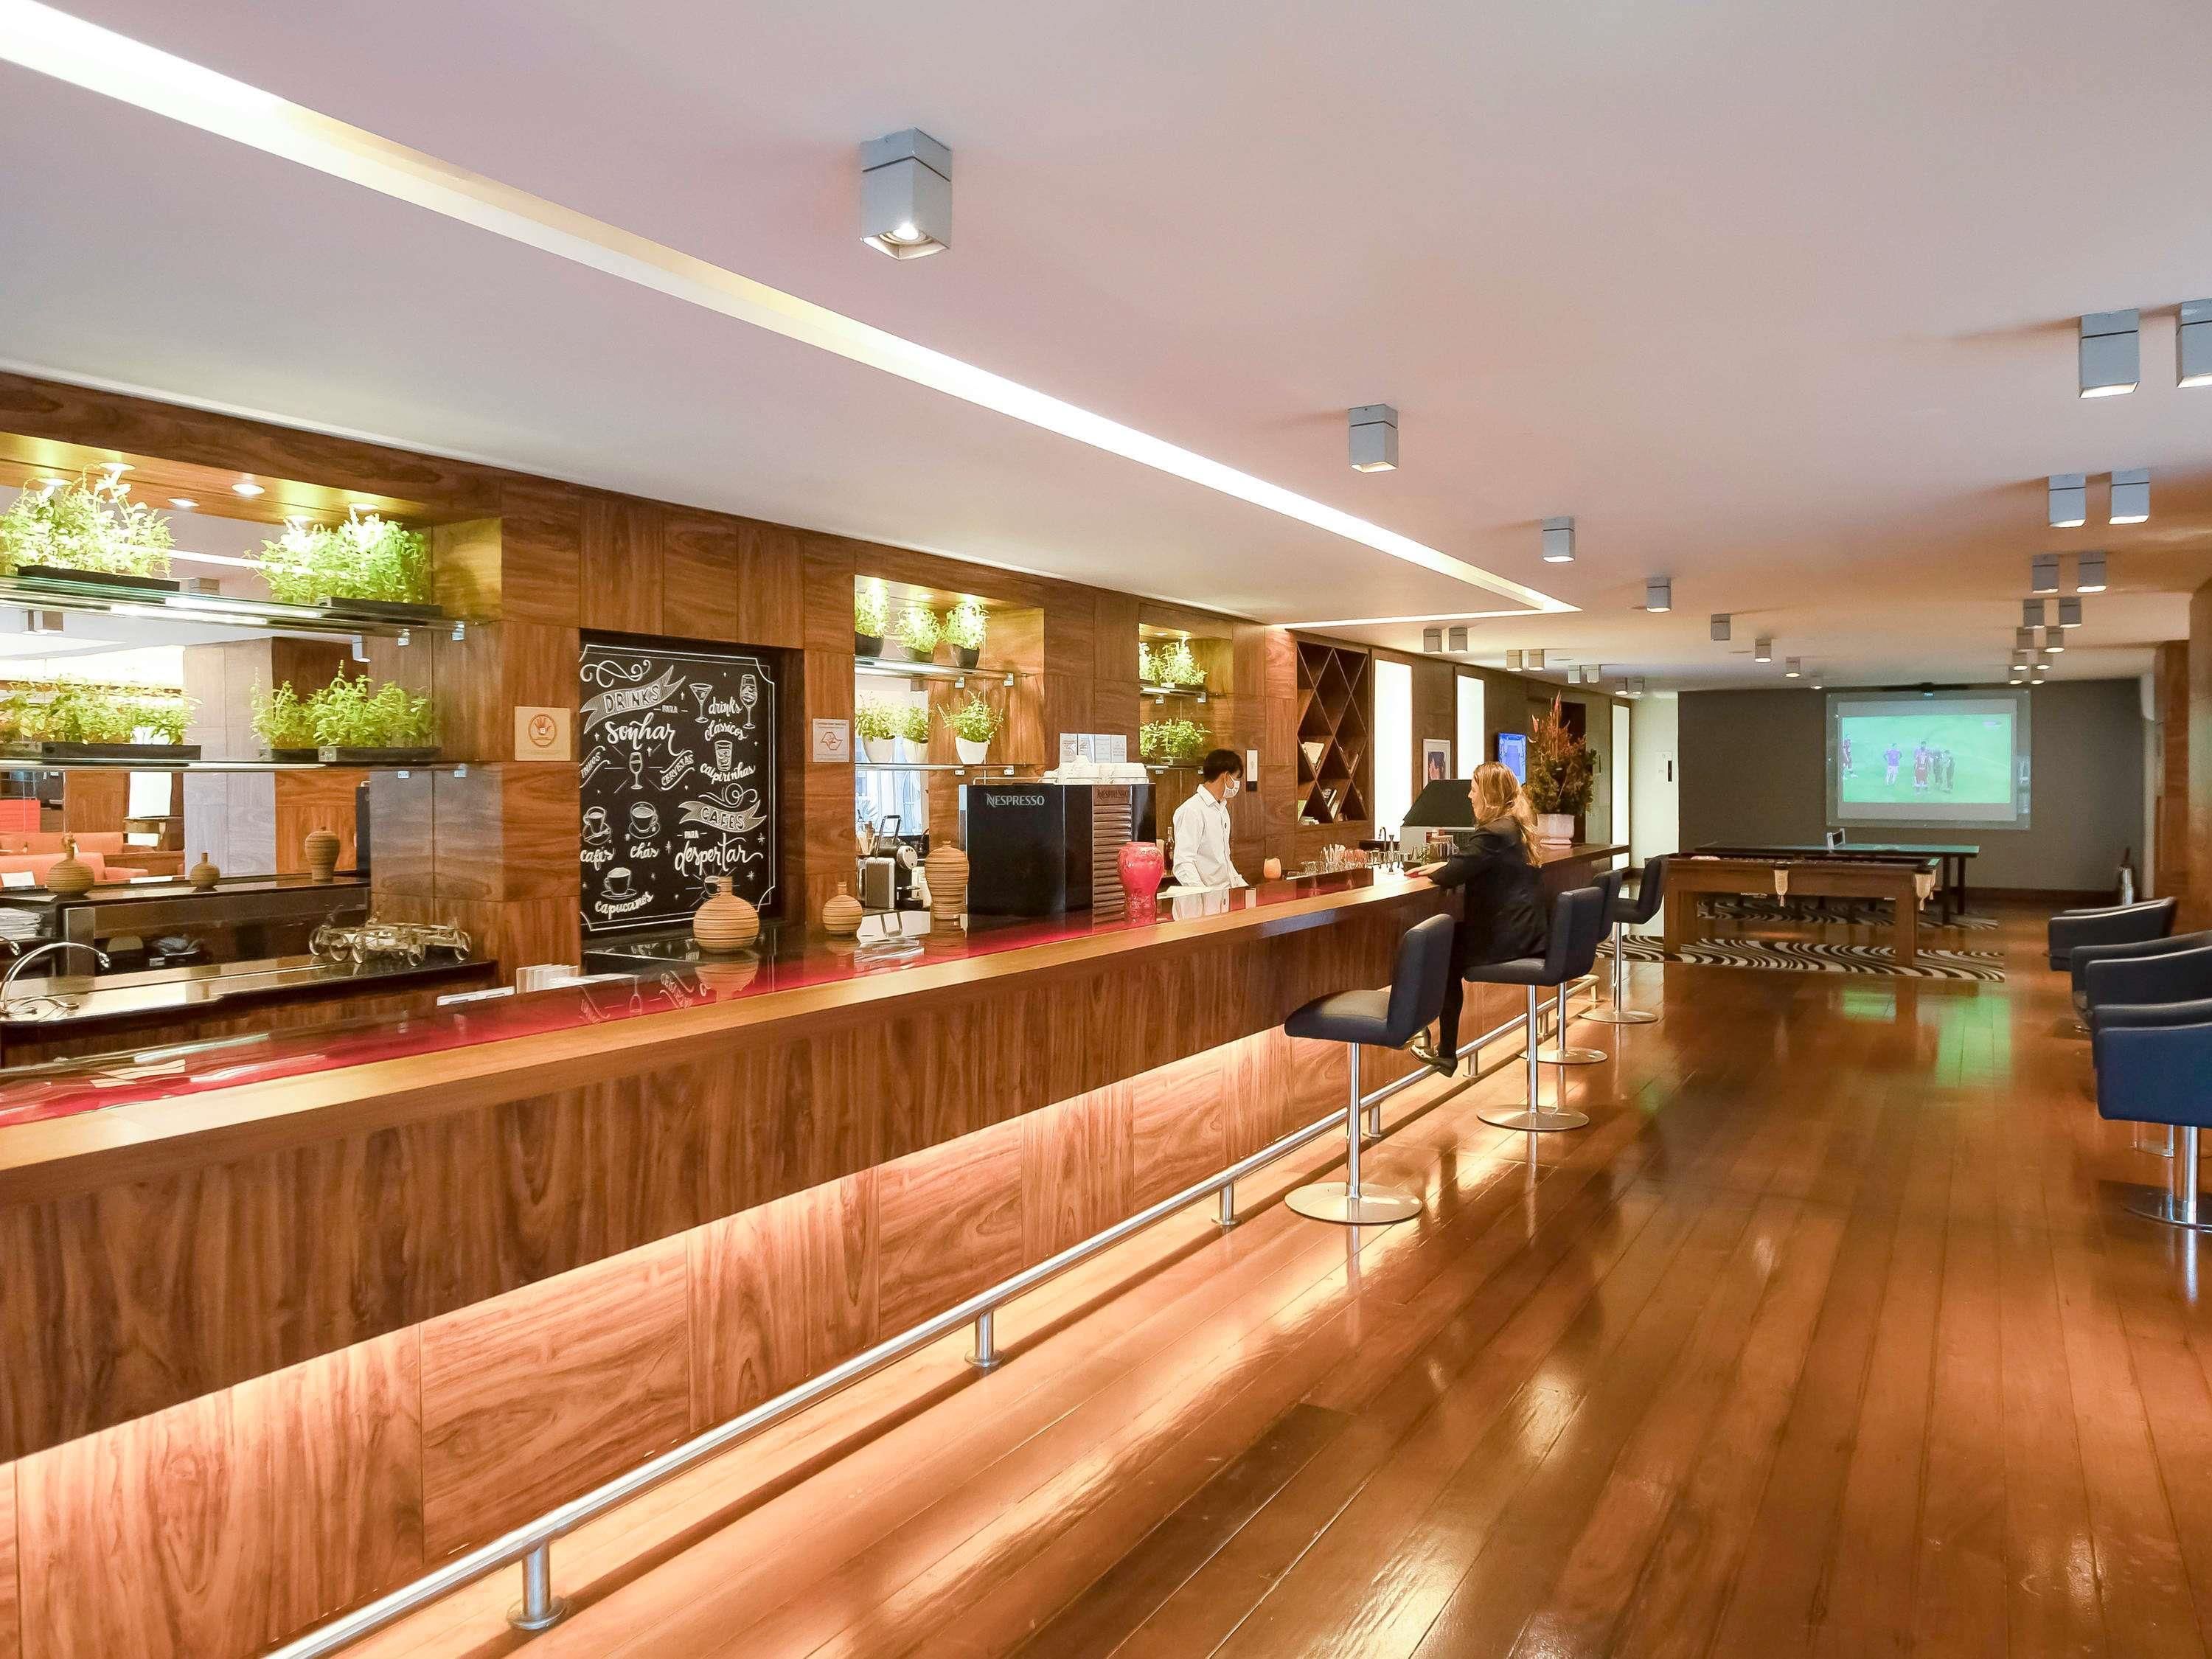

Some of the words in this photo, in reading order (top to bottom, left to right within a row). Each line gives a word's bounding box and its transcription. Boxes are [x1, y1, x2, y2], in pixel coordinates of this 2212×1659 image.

[603, 684, 659, 714] DRINKS
[709, 696, 742, 717] drinks
[661, 754, 694, 785] CERVEJAS
[700, 762, 756, 785] caipirinhas
[986, 793, 1046, 807] NESPRESSO
[675, 832, 763, 877] despertar
